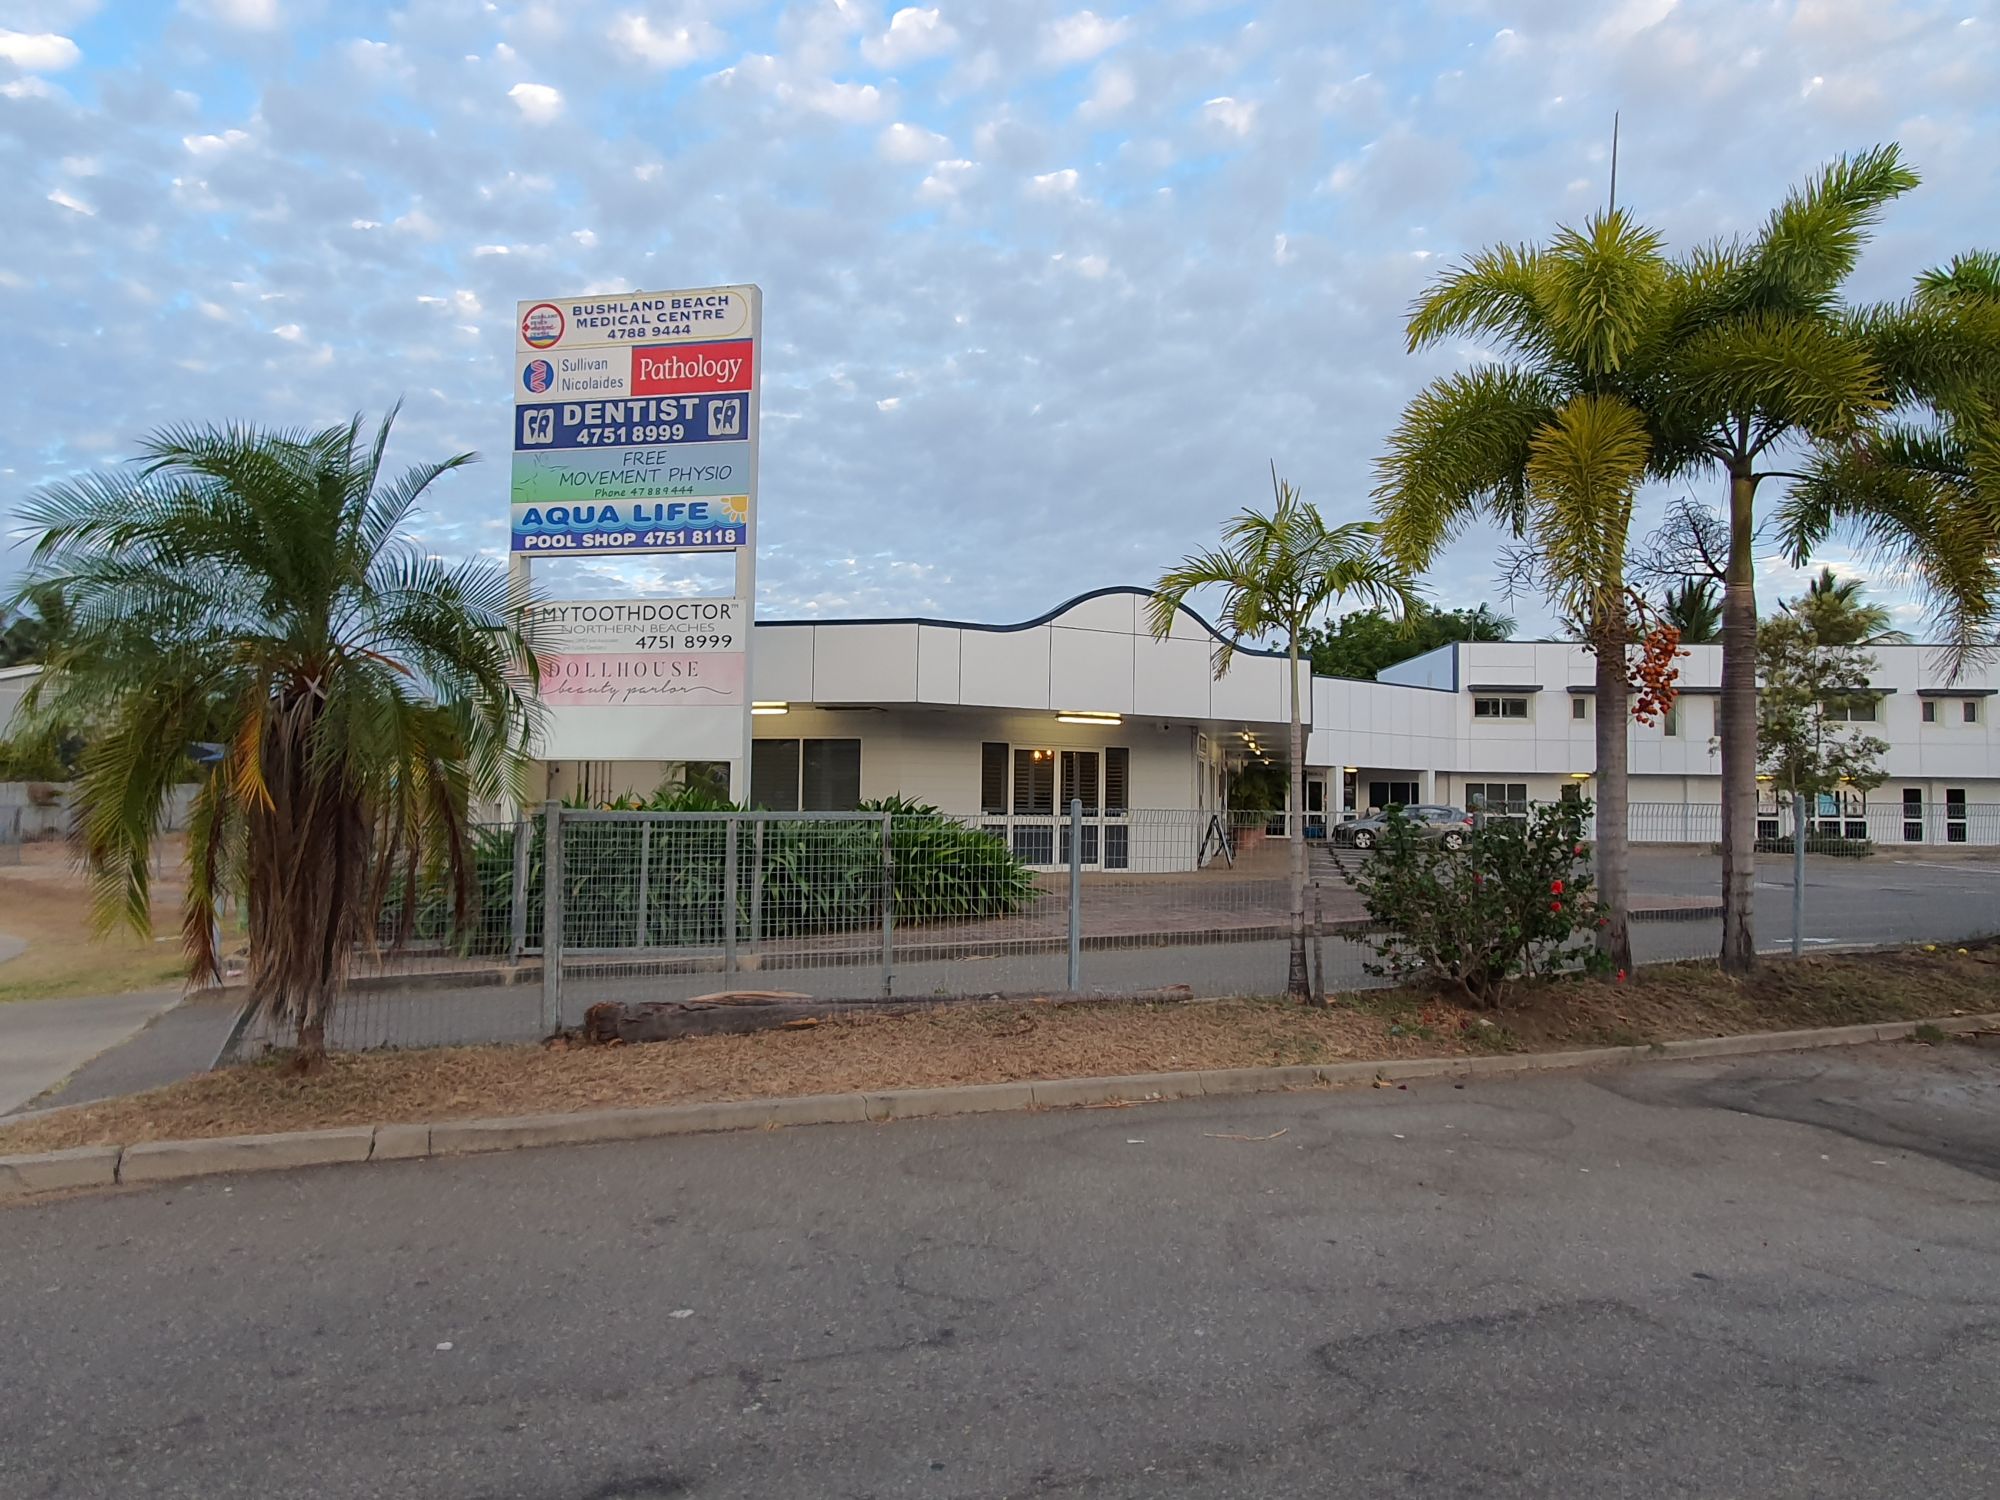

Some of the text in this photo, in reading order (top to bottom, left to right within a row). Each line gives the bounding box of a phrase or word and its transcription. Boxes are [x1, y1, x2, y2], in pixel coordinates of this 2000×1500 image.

[572, 295, 729, 316] BUSHLAND BEACH
[576, 309, 725, 329] MEDICAL CENTRE
[607, 324, 692, 340] 4788 9444
[561, 358, 608, 372] Sullivan
[640, 354, 743, 383] Pathology
[561, 376, 624, 392] Nicolaides
[563, 397, 700, 426] DENTIST
[576, 424, 685, 445] 4751 8999
[623, 450, 668, 467] FREE
[559, 465, 732, 486] MOVEMENT PHYSIO
[594, 488, 626, 498] Phone
[521, 502, 710, 526] AQUA LIFE
[524, 529, 736, 549] POOL SHOP 4751 8118
[561, 622, 716, 634] NORTHERN BEACHES
[635, 634, 733, 650] 4751 8999
[549, 660, 700, 678] DOLLHOUSE
[543, 679, 732, 702] beauty parlor
